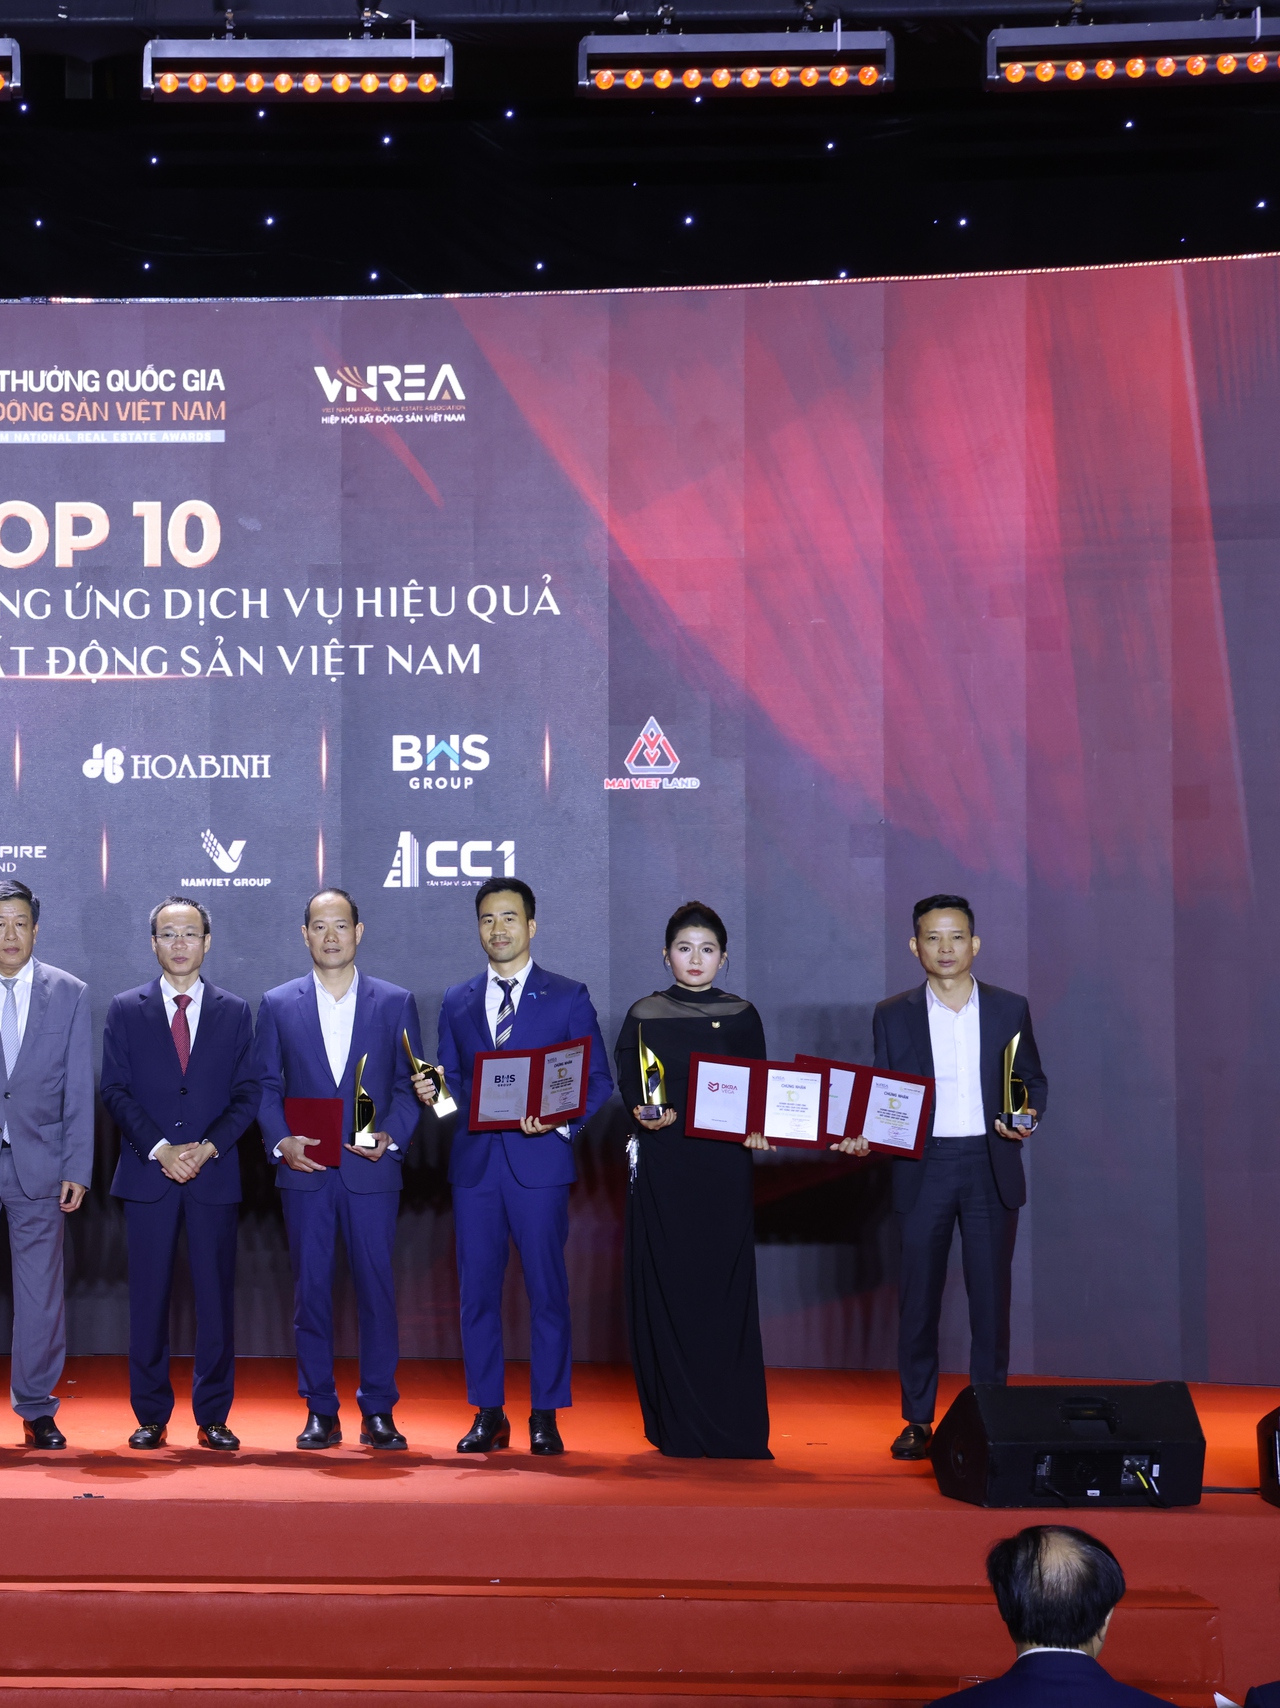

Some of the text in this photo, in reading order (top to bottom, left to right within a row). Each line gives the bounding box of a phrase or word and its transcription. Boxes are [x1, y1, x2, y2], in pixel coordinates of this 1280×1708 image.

[106, 363, 176, 393] QUỐC
[182, 368, 226, 392] GIA
[313, 363, 467, 403] VNREA
[60, 396, 109, 422] SẢN
[115, 398, 166, 424] VIỆT
[172, 400, 226, 421] NAM
[444, 413, 466, 422] NAM
[14, 432, 72, 443] NATIONAL
[77, 432, 108, 443] REAL
[112, 432, 157, 442] ESTATE
[161, 431, 212, 442] AWARDS
[132, 499, 222, 568] 10
[64, 581, 151, 620] ỨNG
[163, 587, 270, 627] DỊCH
[283, 587, 343, 627] VỤ
[355, 578, 457, 624] HIỆU
[466, 573, 561, 625] QUẢ
[46, 639, 168, 684] ĐỘNG
[180, 634, 265, 678] SẢN
[276, 637, 374, 683] VIỆT
[386, 643, 481, 676] NAM
[130, 753, 272, 780] HOABINH
[392, 733, 491, 772] BHS
[408, 776, 475, 790] GROUP
[603, 777, 700, 790] MAI VIET LAND
[425, 840, 516, 878] CC1
[180, 878, 272, 888] NAMVIET GROUP
[494, 1074, 516, 1084] BHS
